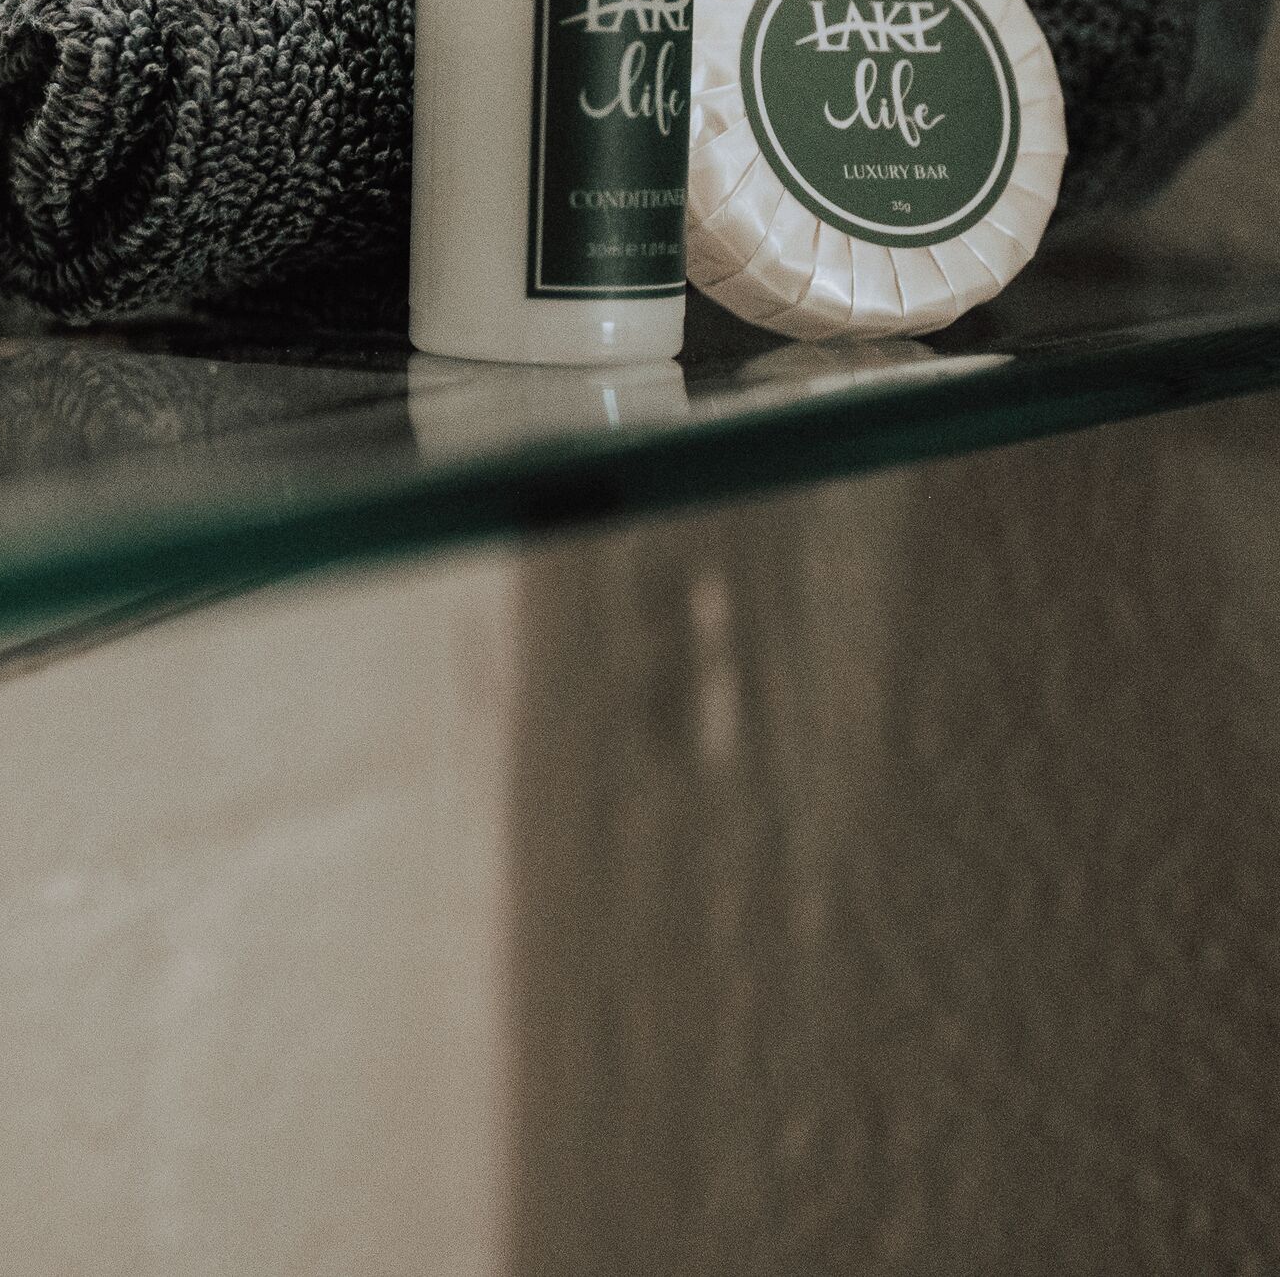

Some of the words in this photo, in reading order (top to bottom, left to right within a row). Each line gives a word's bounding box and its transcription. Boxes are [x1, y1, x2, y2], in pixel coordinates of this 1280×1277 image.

[794, 0, 950, 53] LAKE
[579, 40, 686, 136] life
[824, 57, 946, 148] life
[843, 164, 910, 179] LUXURY
[914, 164, 949, 179] BAR
[891, 200, 911, 214] 35g
